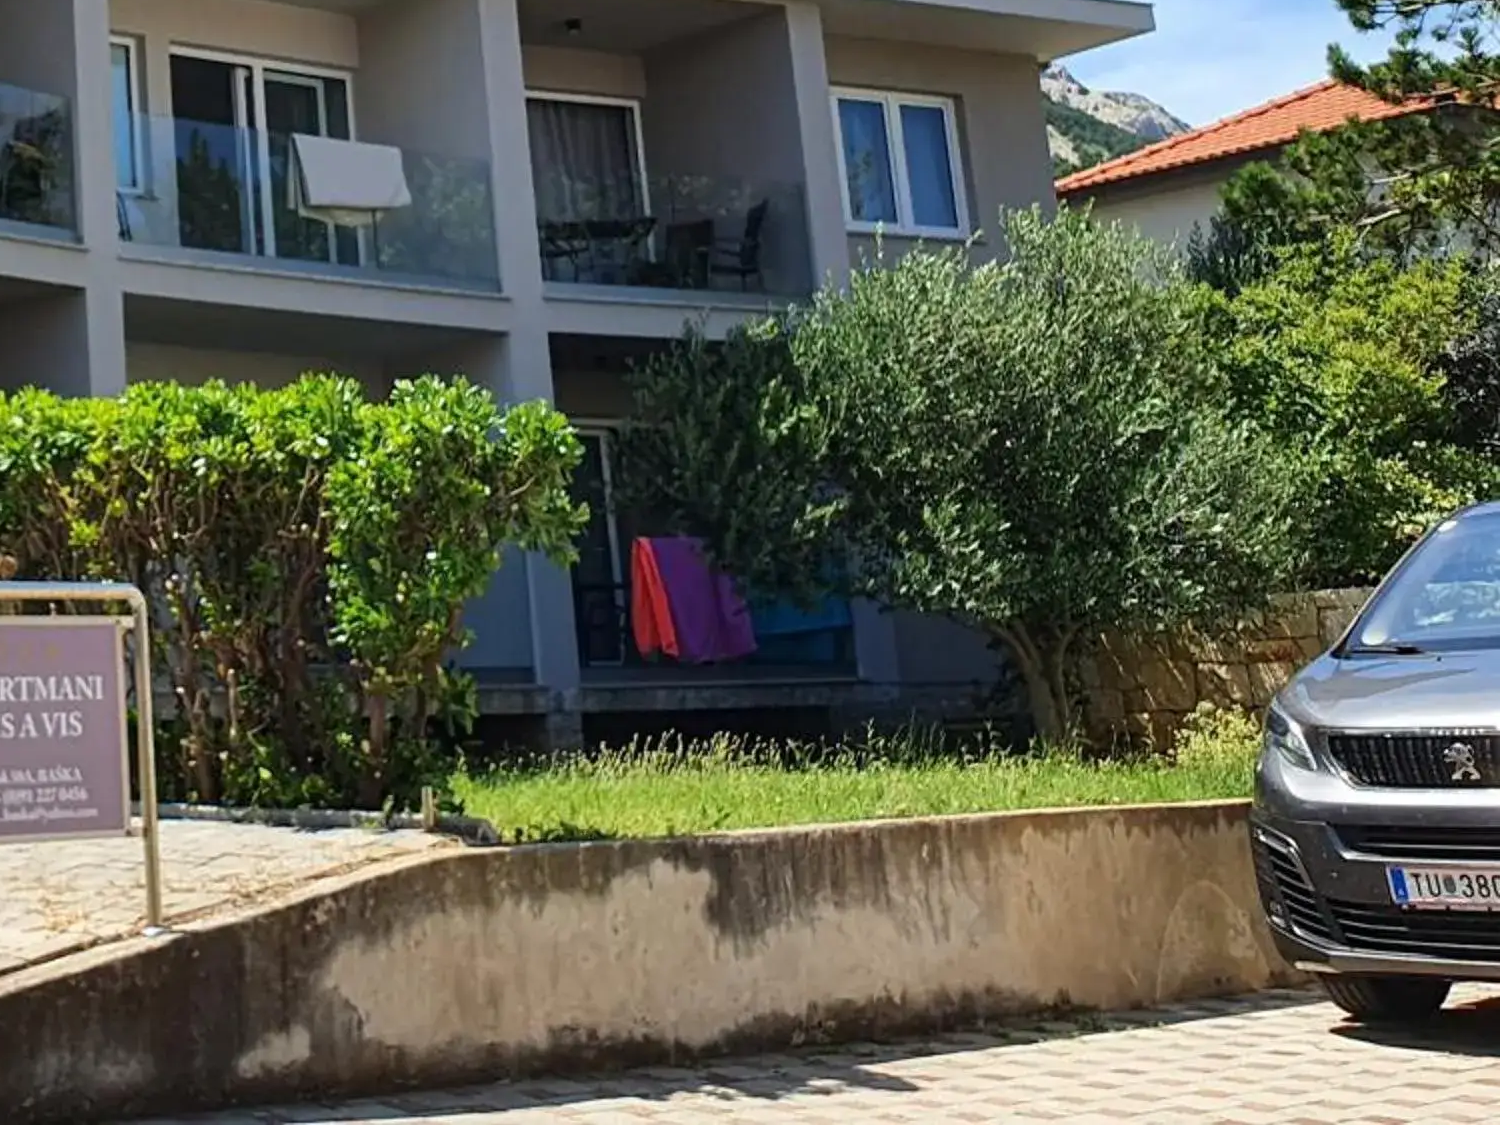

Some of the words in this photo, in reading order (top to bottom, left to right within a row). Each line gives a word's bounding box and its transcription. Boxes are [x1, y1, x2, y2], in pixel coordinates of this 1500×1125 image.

[19, 714, 38, 738] A
[41, 710, 83, 737] VIS
[1410, 872, 1441, 897] TU
